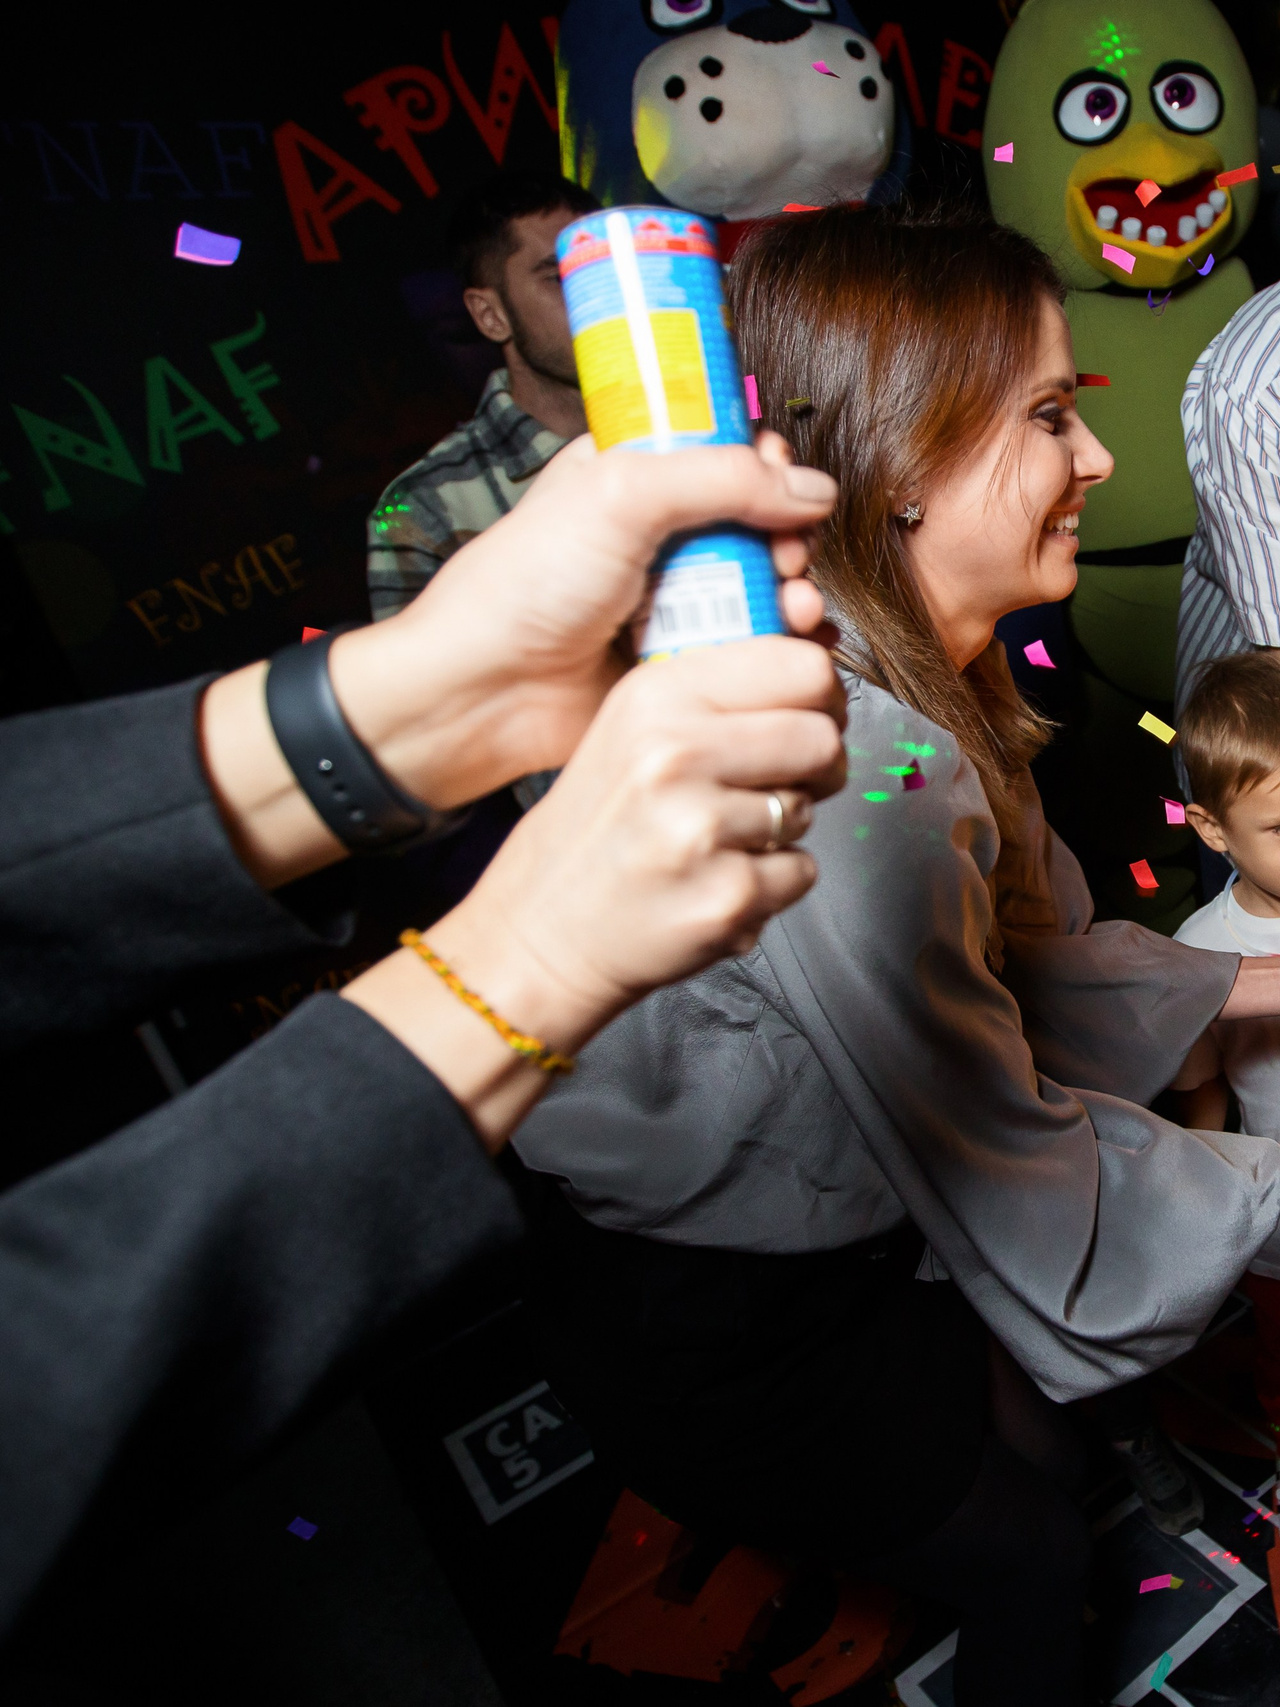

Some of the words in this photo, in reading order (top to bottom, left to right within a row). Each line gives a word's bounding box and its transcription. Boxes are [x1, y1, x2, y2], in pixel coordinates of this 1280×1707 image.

[0, 119, 266, 201] NAF
[0, 310, 282, 535] NAF
[125, 532, 305, 649] FNAF
[484, 1402, 565, 1458] CA
[501, 1449, 542, 1491] 5
